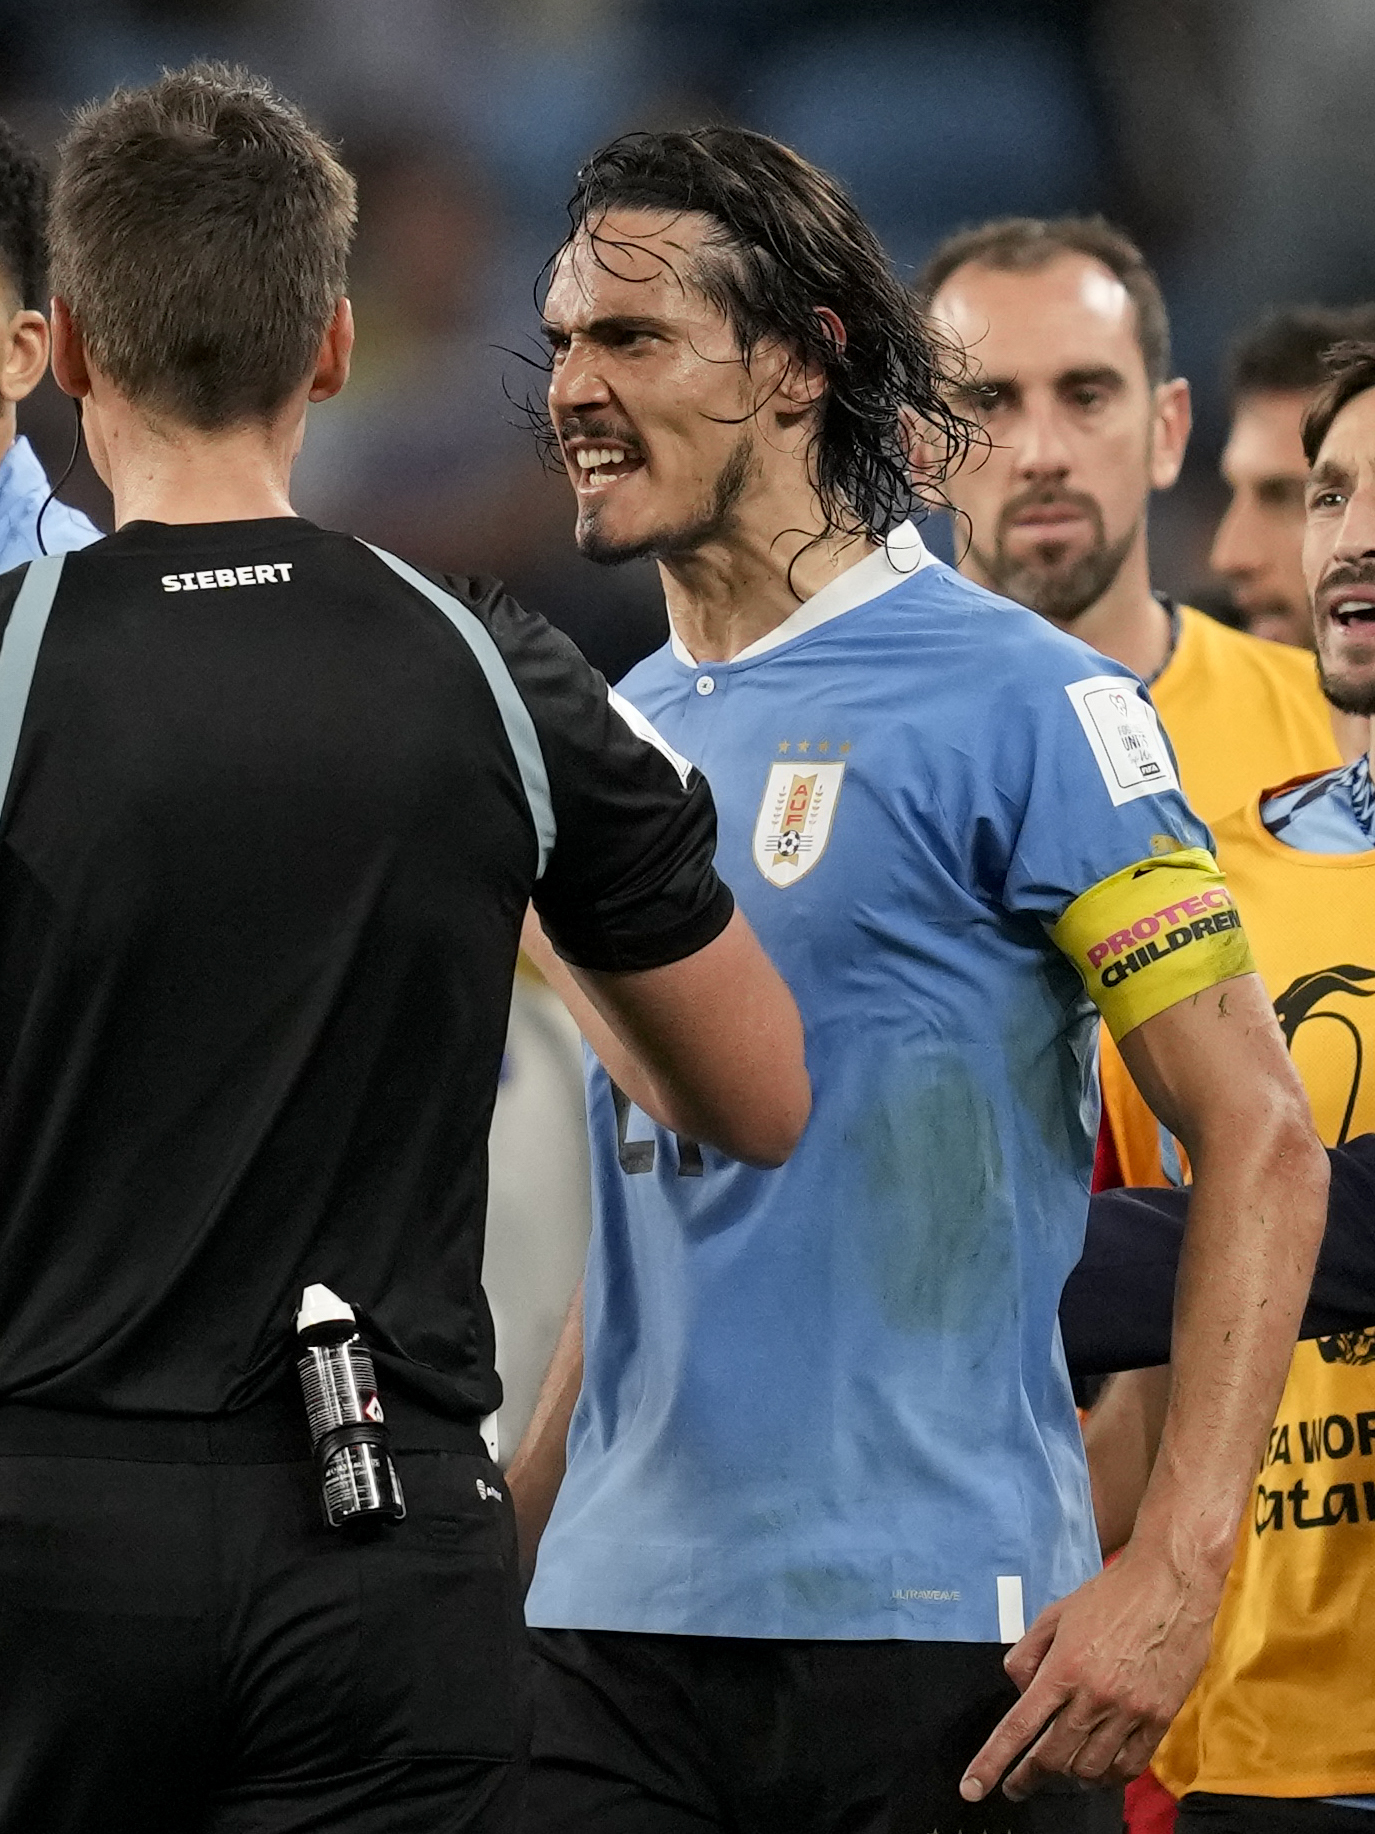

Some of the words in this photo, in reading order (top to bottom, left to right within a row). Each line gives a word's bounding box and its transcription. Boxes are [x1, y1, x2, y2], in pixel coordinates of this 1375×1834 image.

[161, 563, 293, 592] SIEBERT
[785, 784, 809, 827] AUF
[1101, 909, 1242, 988] CHILDREN
